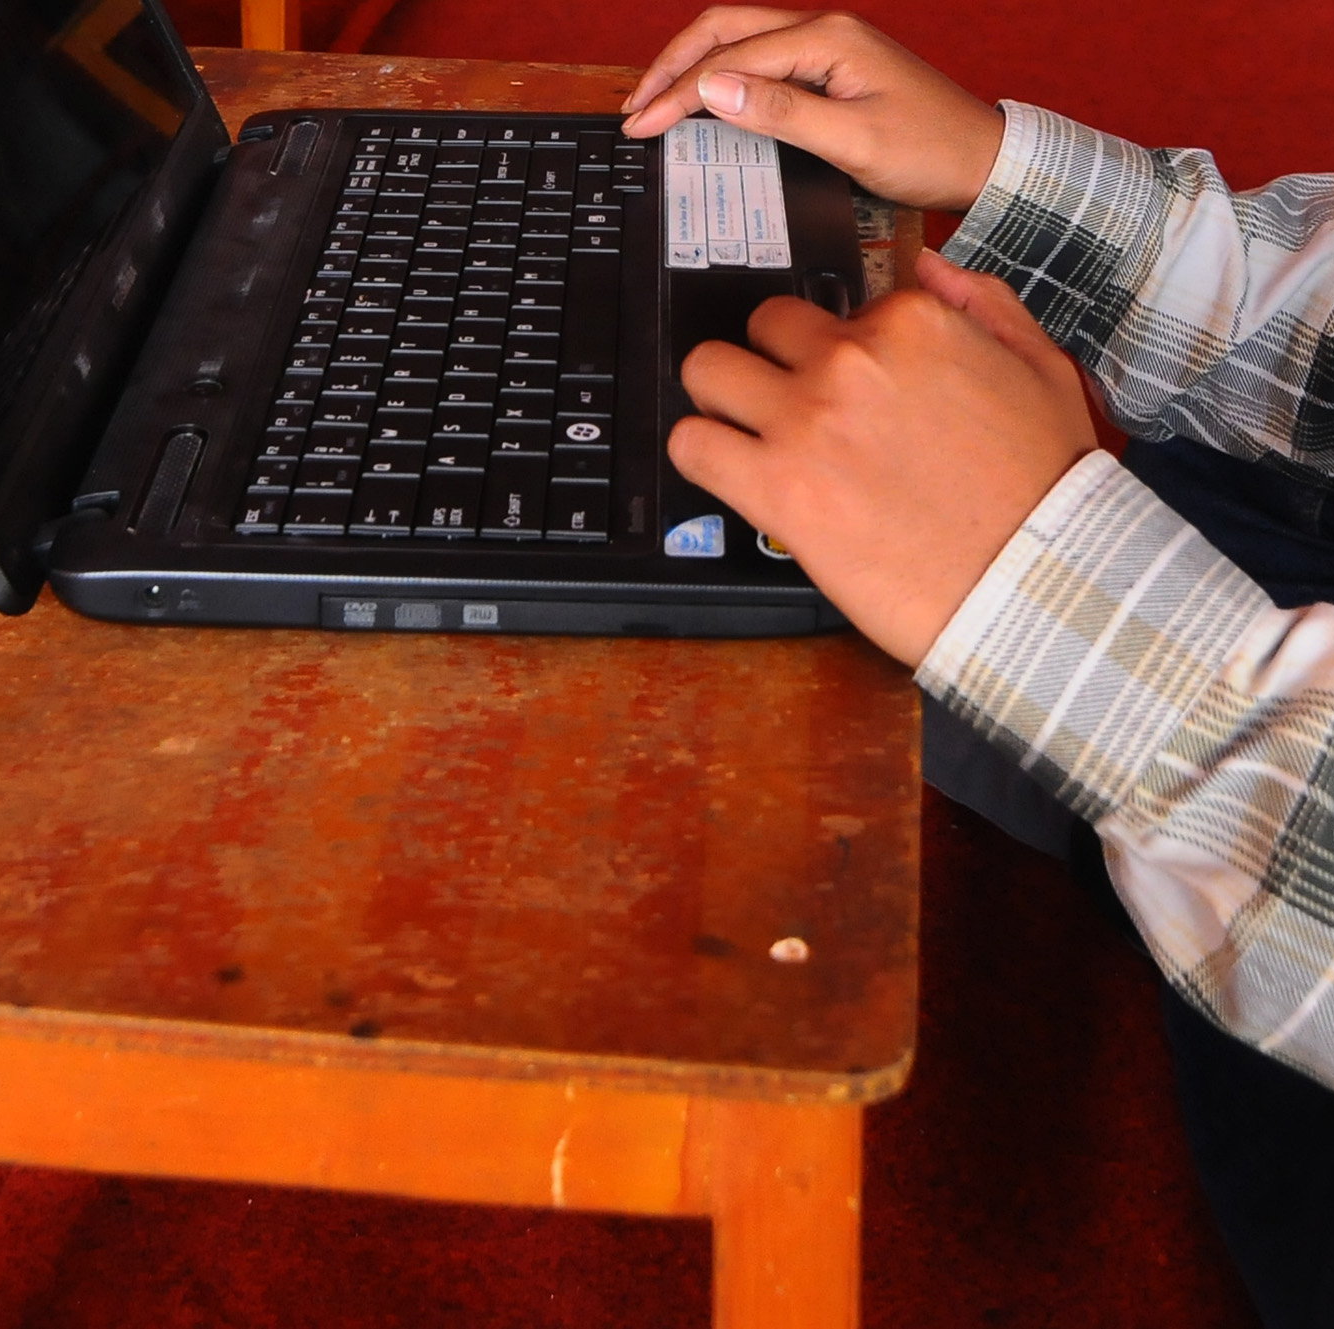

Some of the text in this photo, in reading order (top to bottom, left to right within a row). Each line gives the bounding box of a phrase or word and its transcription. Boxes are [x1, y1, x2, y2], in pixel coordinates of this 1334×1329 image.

[508, 493, 522, 515] SHIFT
[432, 508, 447, 525] CAPS
[449, 508, 463, 526] LOCK
[571, 511, 586, 529] CTRL
